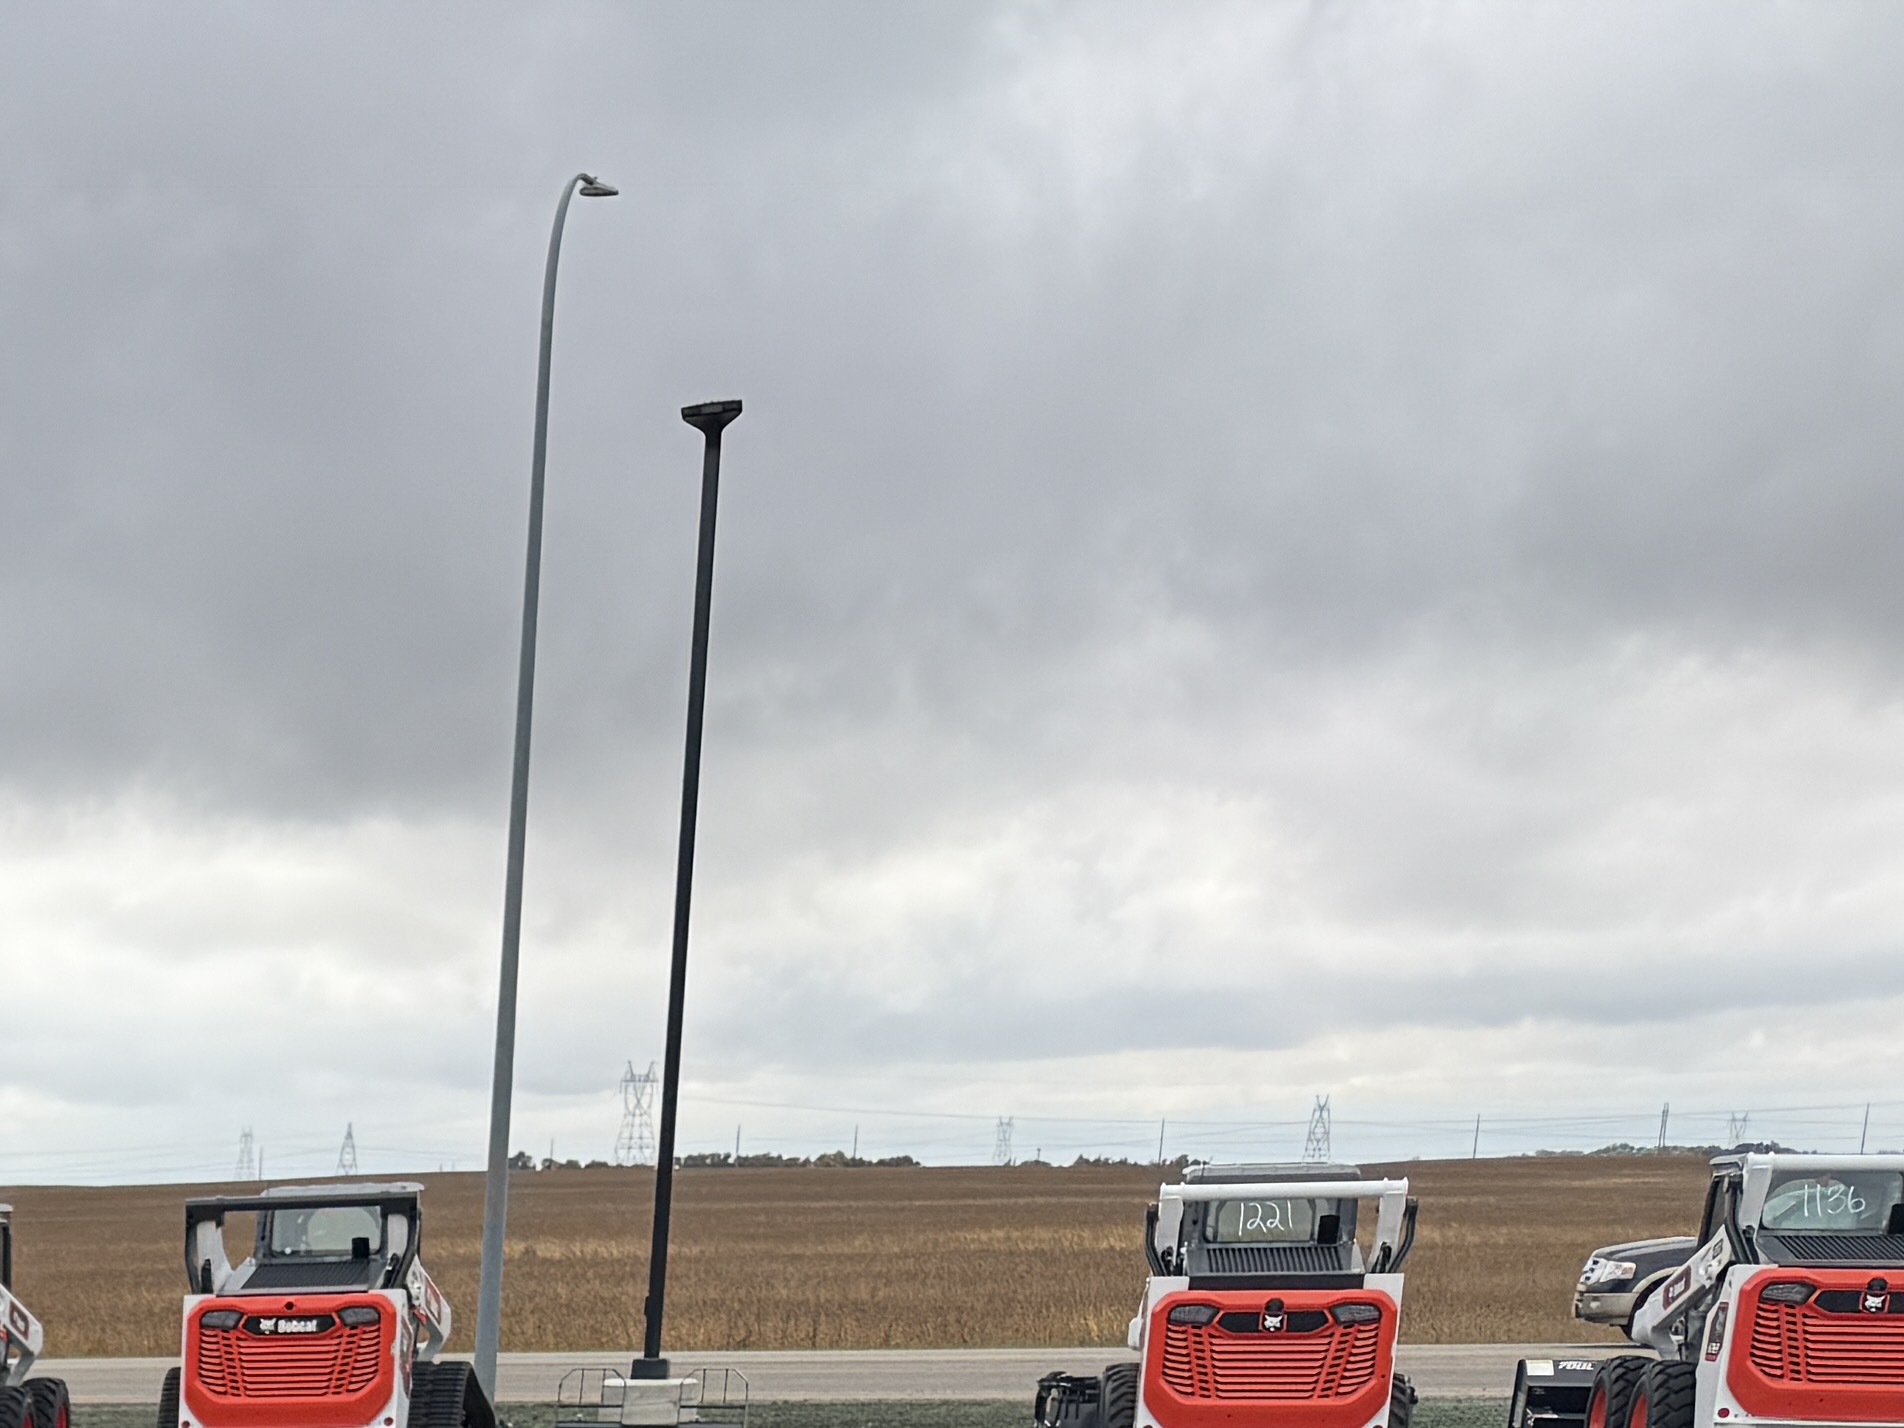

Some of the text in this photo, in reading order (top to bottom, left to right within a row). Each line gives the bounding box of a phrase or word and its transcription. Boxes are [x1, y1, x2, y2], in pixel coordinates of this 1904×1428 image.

[1238, 1199, 1294, 1237] 1221
[1803, 1183, 1866, 1218] 1136
[277, 1318, 318, 1333] Bobcat
